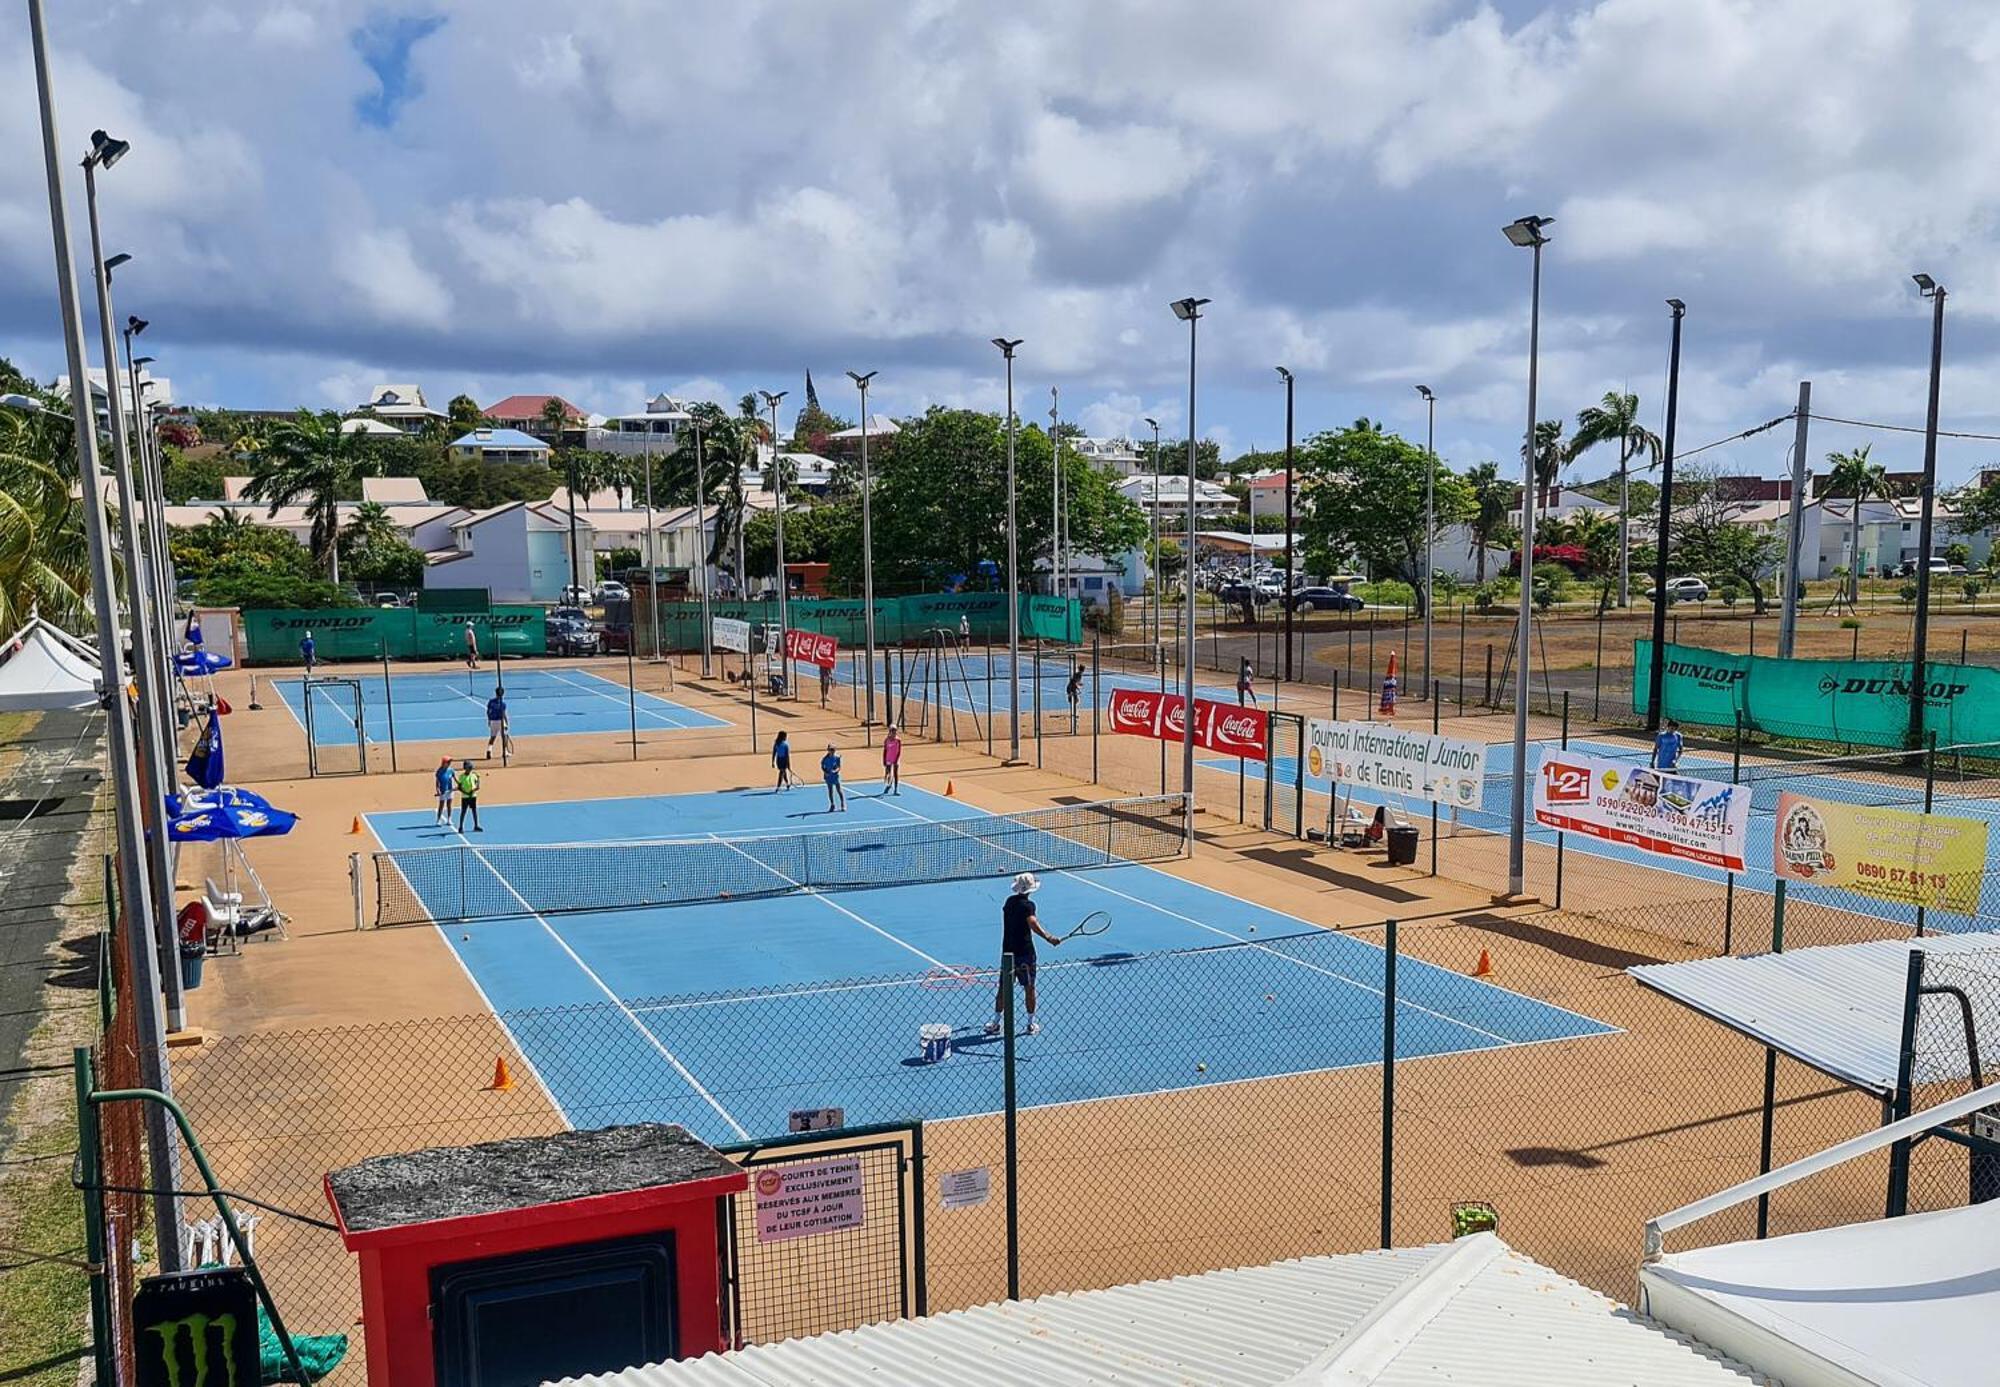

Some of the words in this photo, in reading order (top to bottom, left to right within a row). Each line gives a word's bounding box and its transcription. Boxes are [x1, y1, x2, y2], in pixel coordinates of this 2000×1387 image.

[288, 615, 376, 629] DUNLOP
[1667, 660, 1747, 684] DUNLOP
[1698, 681, 1734, 692] SPORT
[1841, 678, 1968, 700] DUNOP
[1311, 723, 1350, 750] Tournoi
[1352, 729, 1430, 763] International
[1432, 738, 1480, 771] Junior
[1357, 760, 1370, 782] de
[1375, 762, 1412, 790] Tennis
[1597, 796, 1618, 810] 0590
[1857, 862, 1887, 880] 0690
[1890, 868, 1906, 882] 67
[782, 1170, 815, 1182] COURTS
[817, 1167, 829, 1176] DE
[830, 1163, 860, 1175] TENNIS
[785, 1176, 853, 1193] EXCLUSIVEMENT
[802, 1195, 820, 1204] AUX
[821, 1187, 861, 1201] MEMBRES
[777, 1211, 789, 1220] DU
[821, 1202, 844, 1213] JOUR
[766, 1225, 777, 1233] DE
[780, 1221, 801, 1231] LEUR
[803, 1213, 853, 1227] COTISATION
